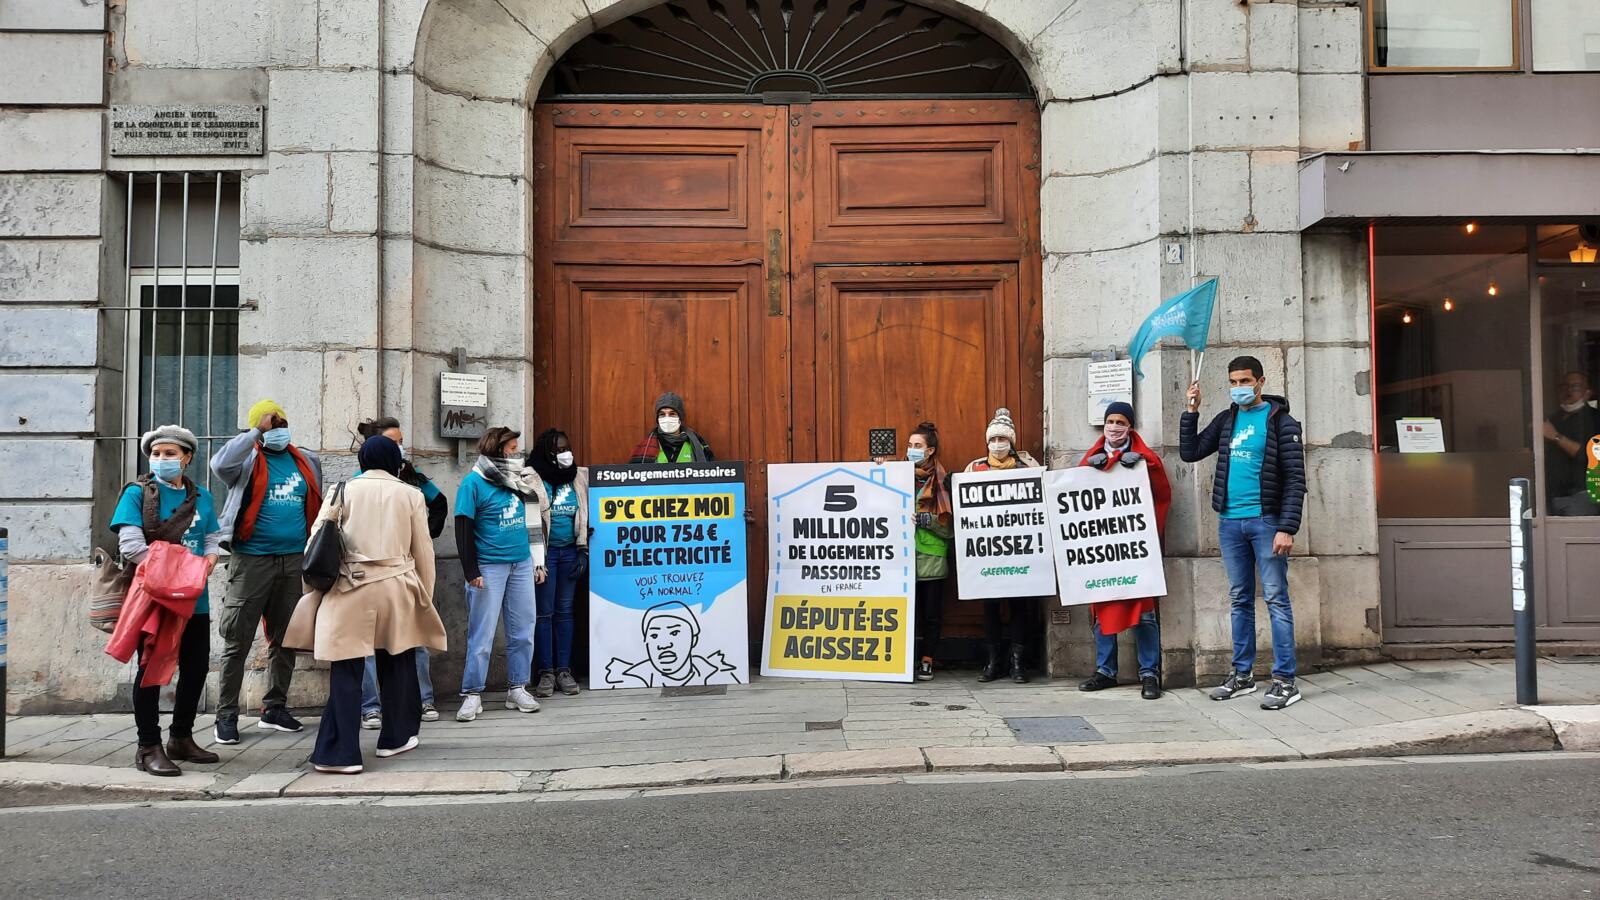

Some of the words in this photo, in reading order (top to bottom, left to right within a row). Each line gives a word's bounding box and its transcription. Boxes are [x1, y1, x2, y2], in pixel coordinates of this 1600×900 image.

[113, 121, 125, 129] DE
[126, 121, 136, 129] LA
[191, 121, 201, 129] DE
[154, 111, 185, 119] ANCIEN
[191, 111, 218, 119] HOTEL
[596, 466, 737, 482] #StopLogementsPassoires
[823, 484, 857, 512] 5
[961, 485, 983, 504] LOI
[1057, 487, 1107, 514] STOP
[1112, 487, 1142, 507] AUX
[604, 499, 635, 520] 9°C
[640, 498, 689, 518] CHEZ
[694, 496, 730, 516] MOI
[793, 517, 889, 539] MILLIONS
[980, 515, 994, 529] LA
[996, 508, 1045, 528] DÉPUTÉE
[1060, 513, 1147, 541] LOGEMENTS
[617, 525, 667, 544] POUR
[671, 523, 704, 542] 754
[706, 523, 718, 541] €
[604, 540, 732, 567] D'ÉLECTRICITÉ
[788, 545, 806, 560] DE
[810, 545, 894, 560] LOGEMENTS
[965, 534, 1034, 557] AGISSEZ
[1037, 532, 1044, 554] !
[1066, 540, 1149, 566] PASSOIRES
[634, 574, 658, 586] VOUS
[661, 572, 704, 583] TROUVEZ
[801, 565, 881, 580] PASSOIRES
[980, 566, 1030, 577] GREENPEACE
[639, 587, 653, 600] ÇA
[657, 586, 693, 596] NORMAL
[695, 582, 702, 596] ?
[821, 585, 832, 593] EN
[835, 582, 862, 591] FRANCE
[1085, 575, 1138, 589] GREENPEACE
[784, 635, 880, 661] AGISSEZ
[884, 637, 892, 662] !
